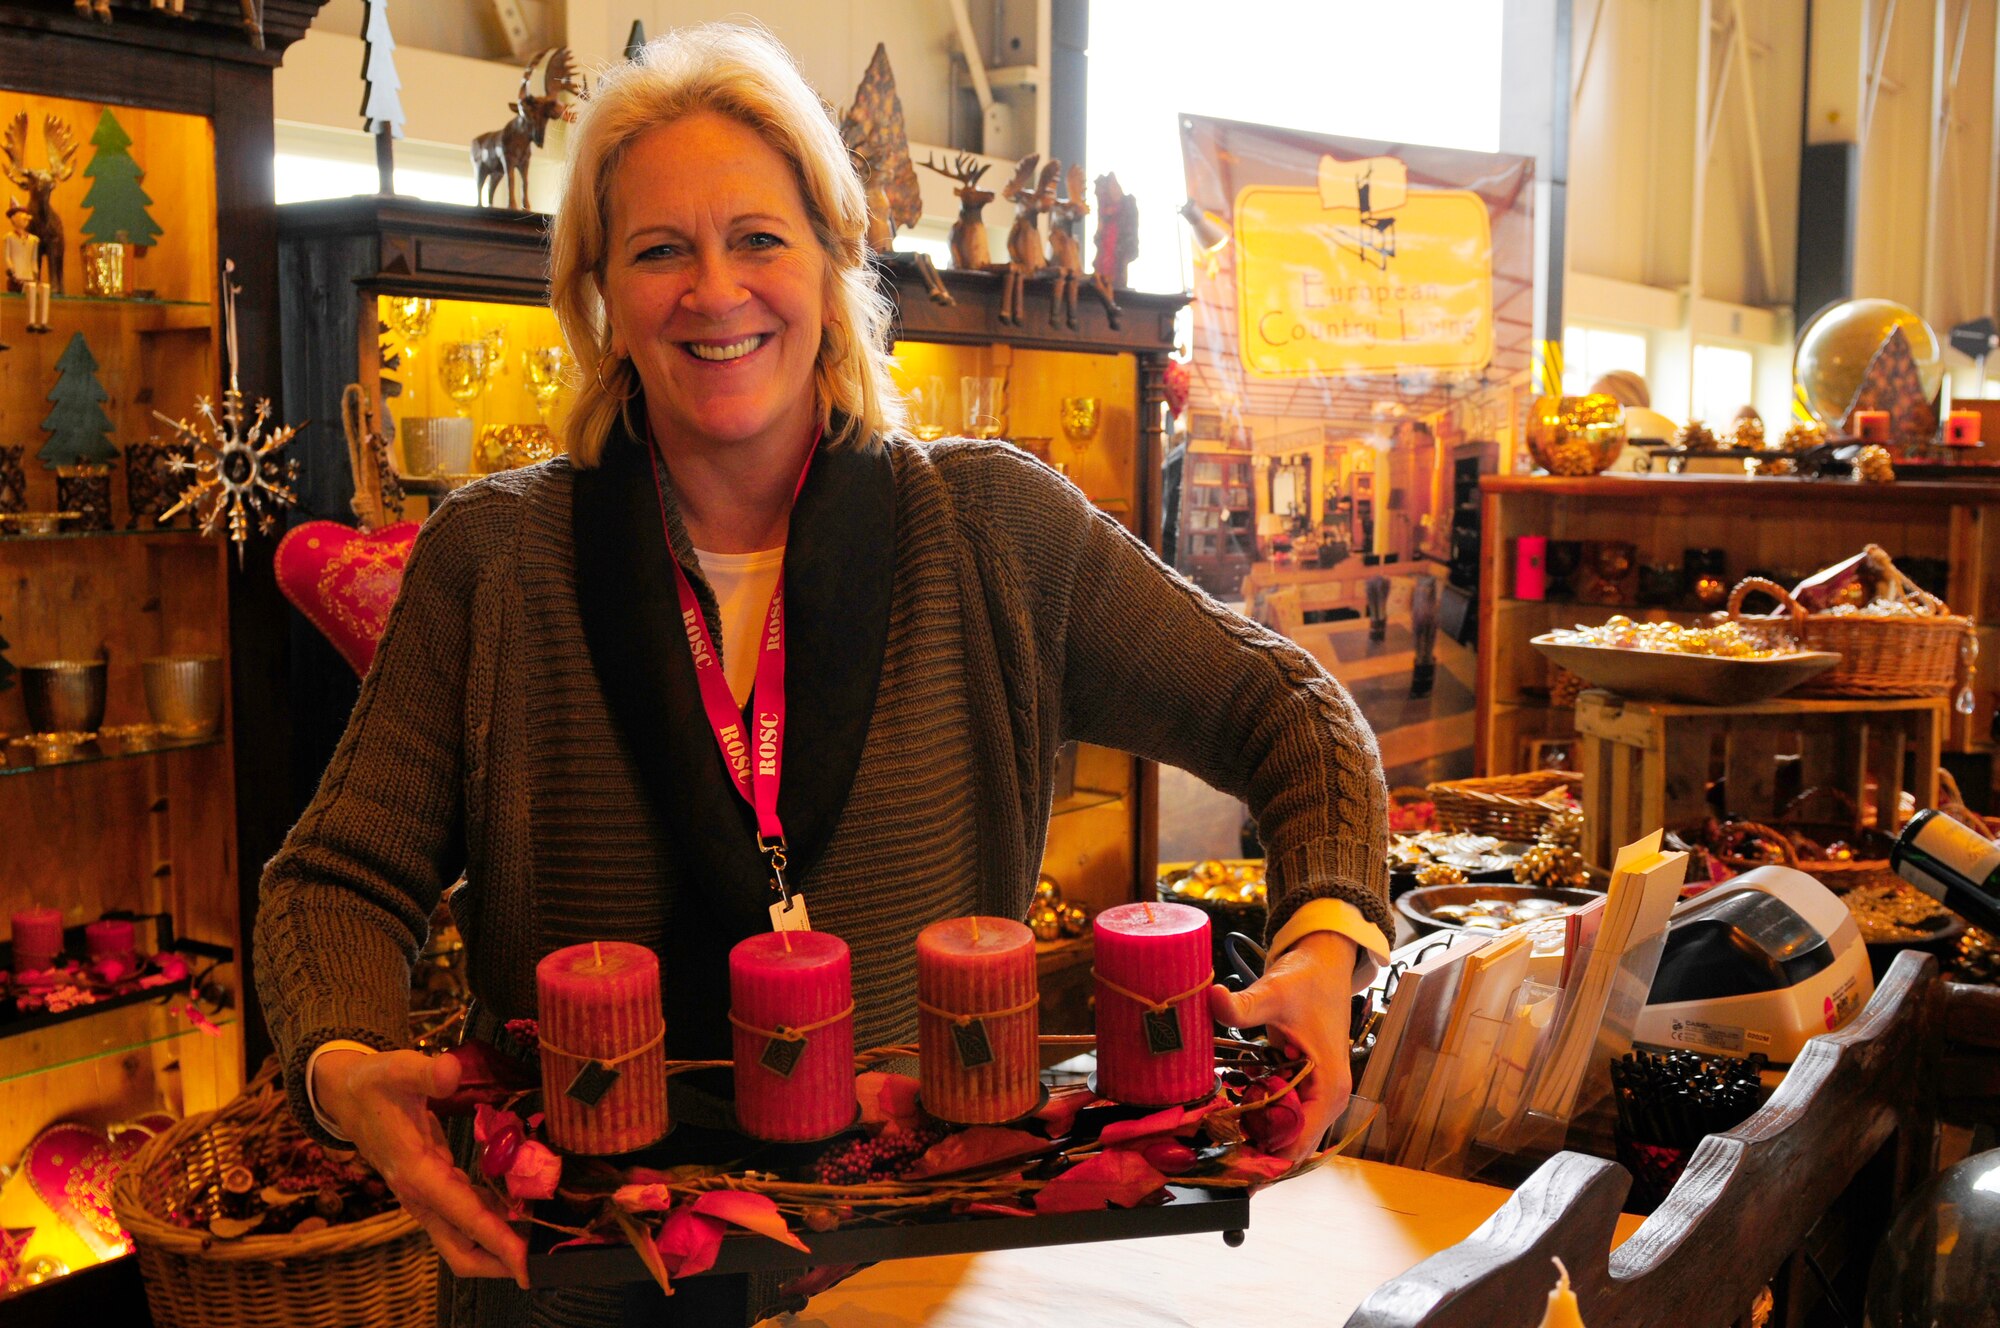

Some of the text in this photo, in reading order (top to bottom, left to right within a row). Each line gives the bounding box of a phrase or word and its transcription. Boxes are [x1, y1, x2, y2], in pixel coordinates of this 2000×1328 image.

[1303, 273, 1439, 315] European
[1259, 308, 1477, 350] Country Living
[682, 607, 713, 669] ROSC
[767, 590, 782, 651] ROSC
[719, 723, 754, 785] ROSC
[758, 712, 779, 777] ROSC
